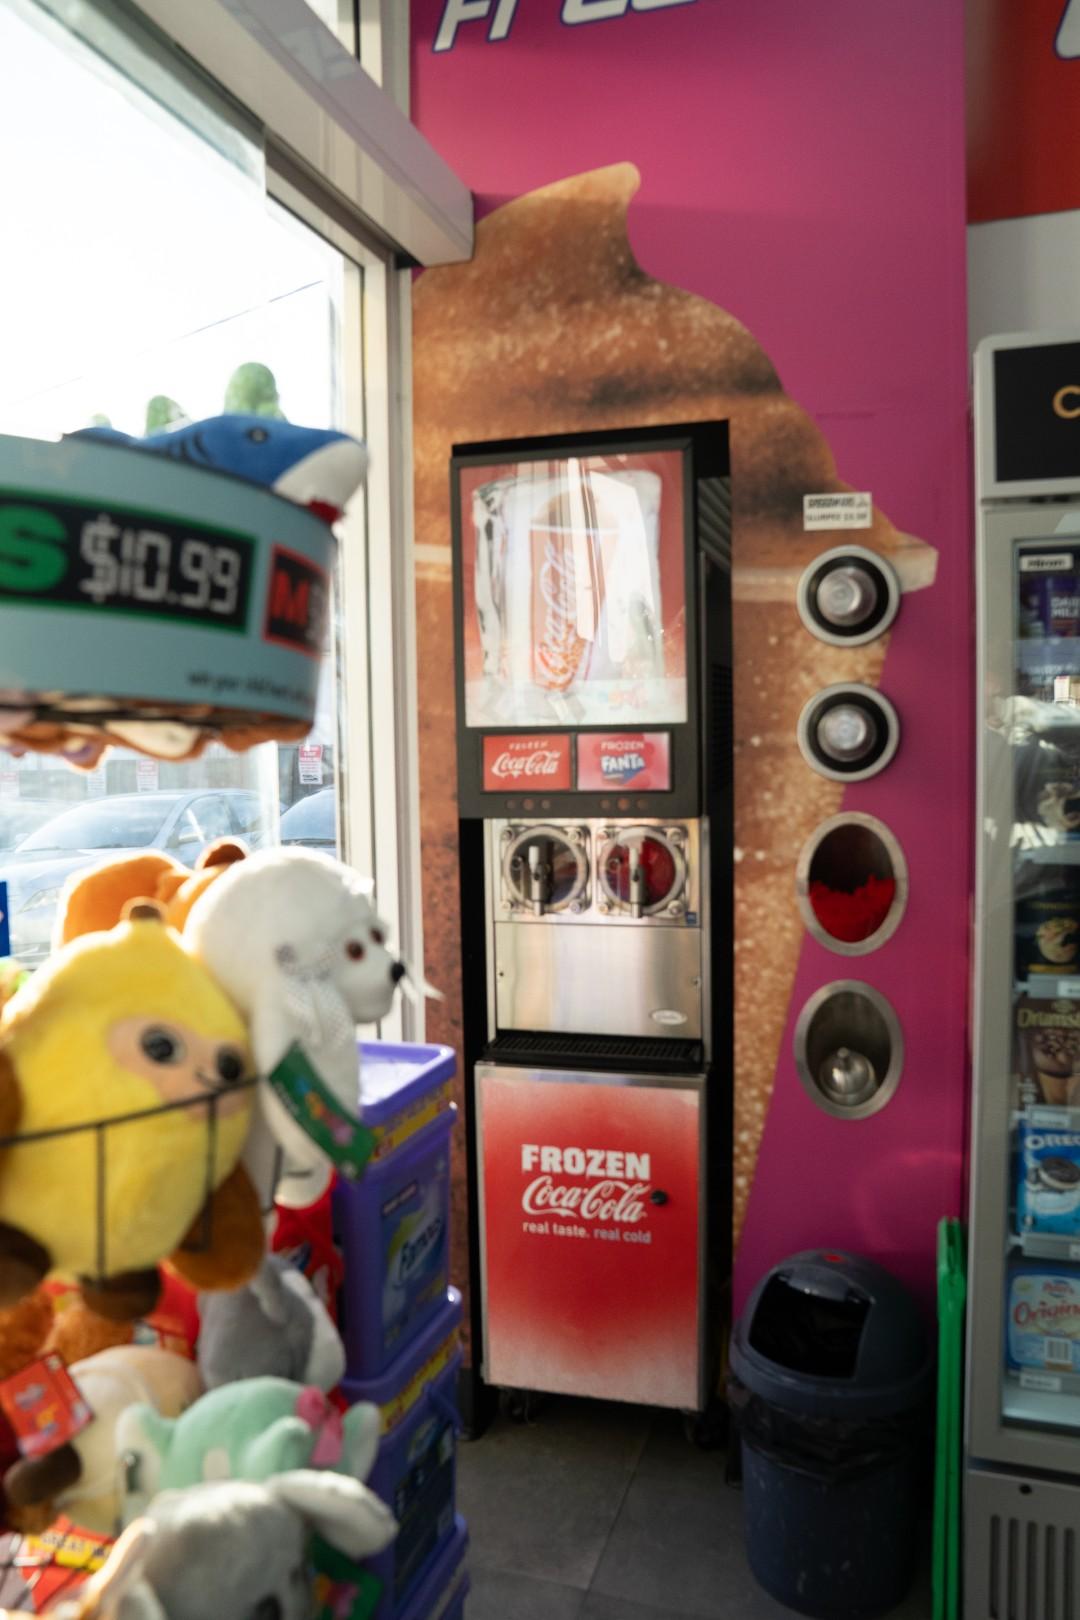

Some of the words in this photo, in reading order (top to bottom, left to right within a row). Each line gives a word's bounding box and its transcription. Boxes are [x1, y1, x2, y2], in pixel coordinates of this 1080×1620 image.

[79, 512, 242, 615] $10.99
[601, 740, 645, 750] FROZEN
[521, 1143, 651, 1181] FROZEN
[522, 1221, 549, 1235] real
[552, 1222, 590, 1239] taste.
[593, 1228, 620, 1241] real
[623, 1230, 652, 1245] cold
